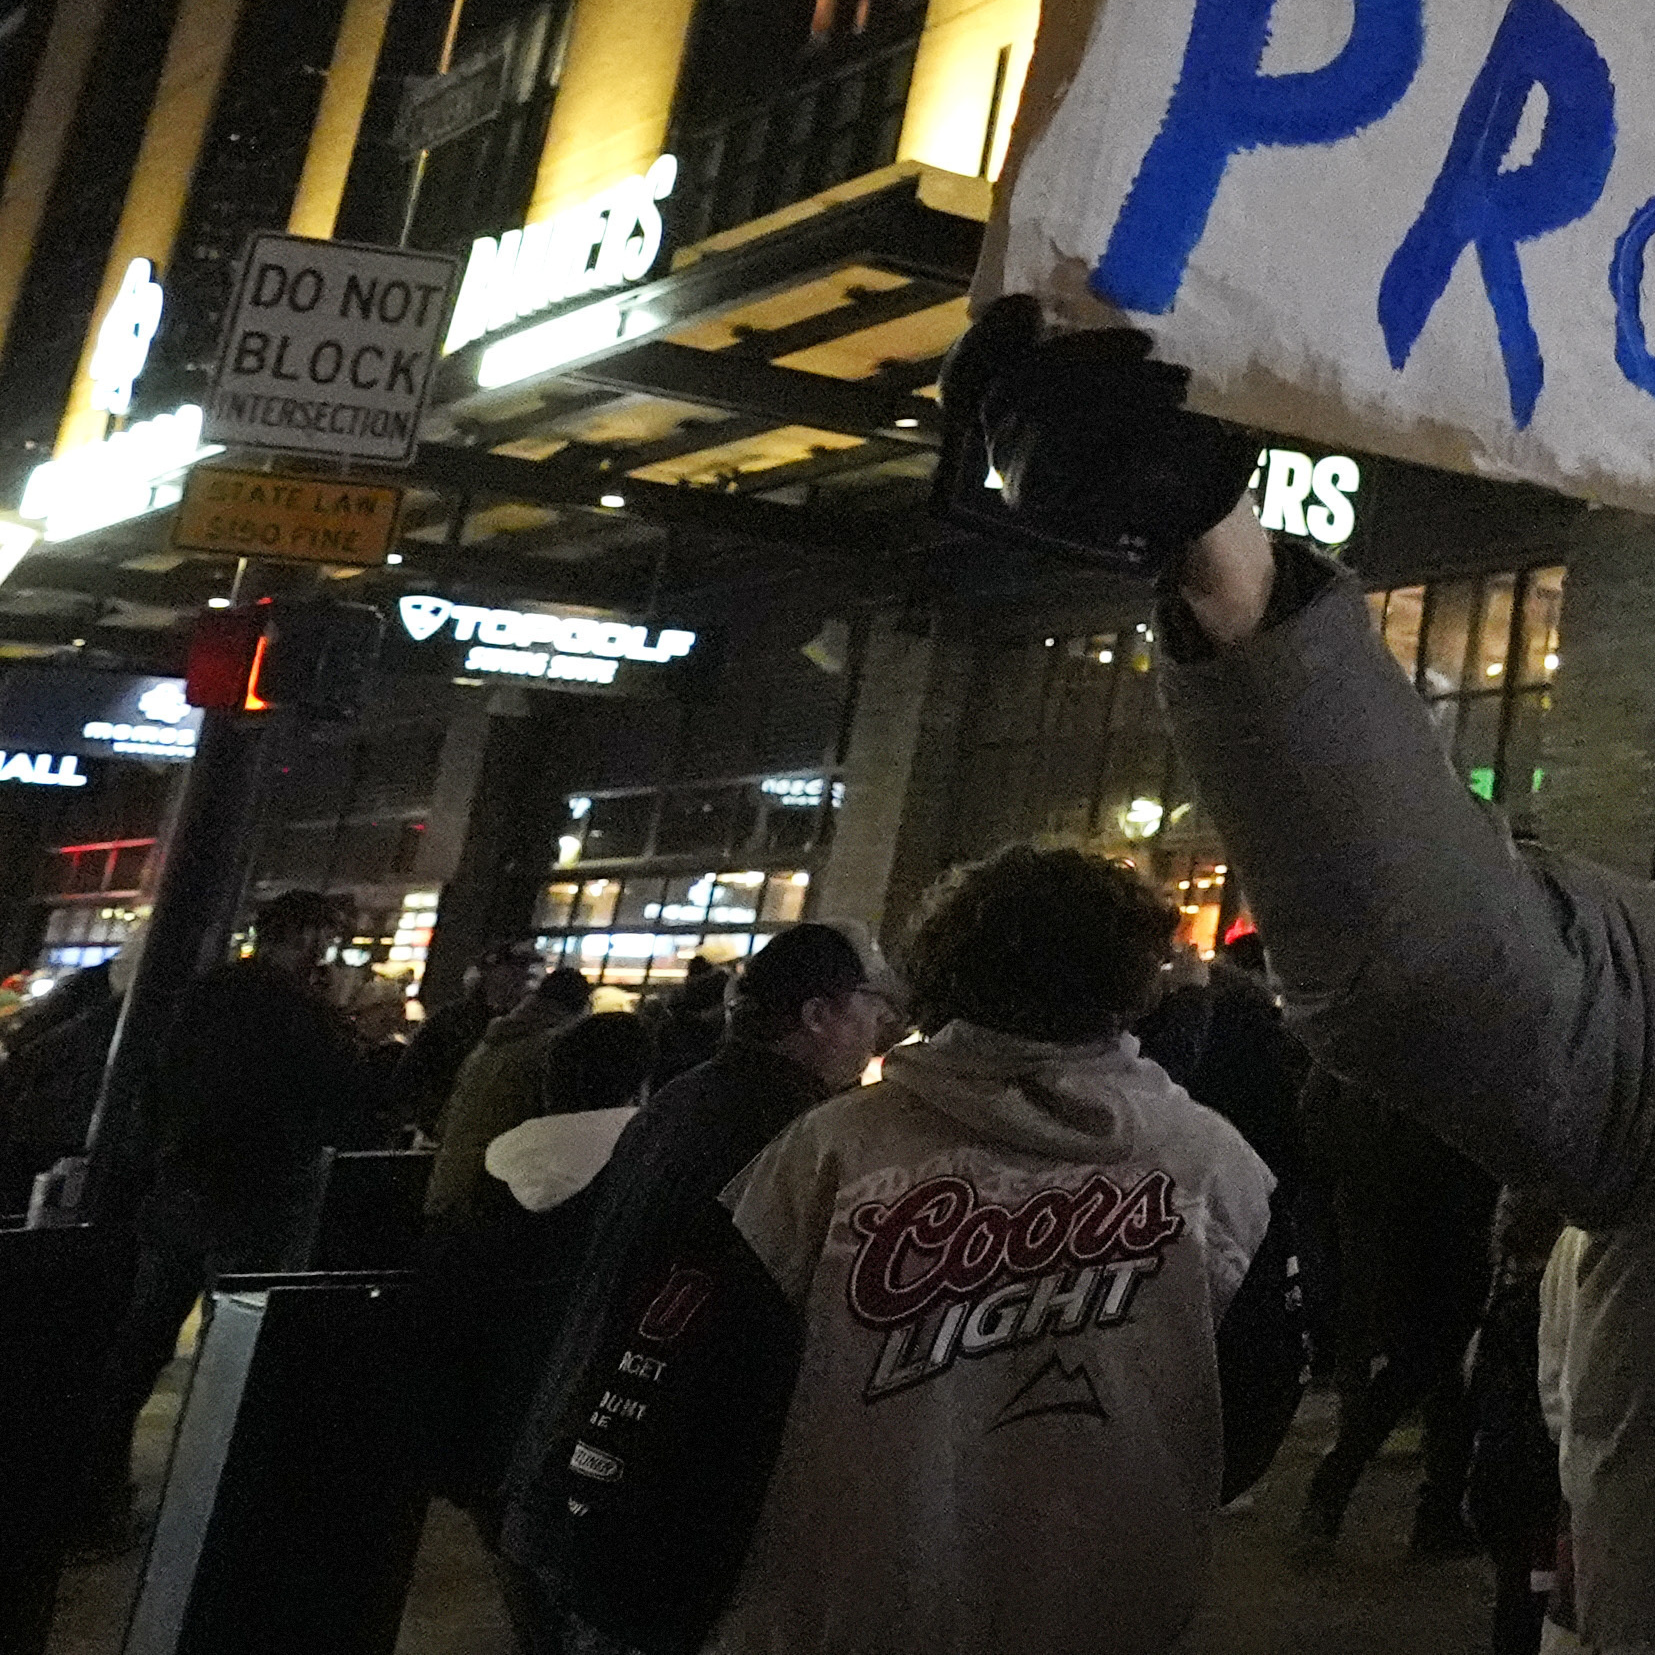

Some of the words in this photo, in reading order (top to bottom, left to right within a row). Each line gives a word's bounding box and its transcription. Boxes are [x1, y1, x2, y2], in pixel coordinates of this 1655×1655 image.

[248, 262, 325, 314] DO
[339, 274, 444, 328] NOT
[232, 330, 422, 396] BLOCK
[212, 395, 409, 440] INTERSECTION
[206, 479, 301, 512] STATE
[312, 488, 377, 514] LAW
[290, 523, 361, 553] FINE
[450, 603, 697, 663] TOPGOLF
[848, 1168, 1185, 1328] Coors
[864, 1255, 1162, 1404] LIGHT
